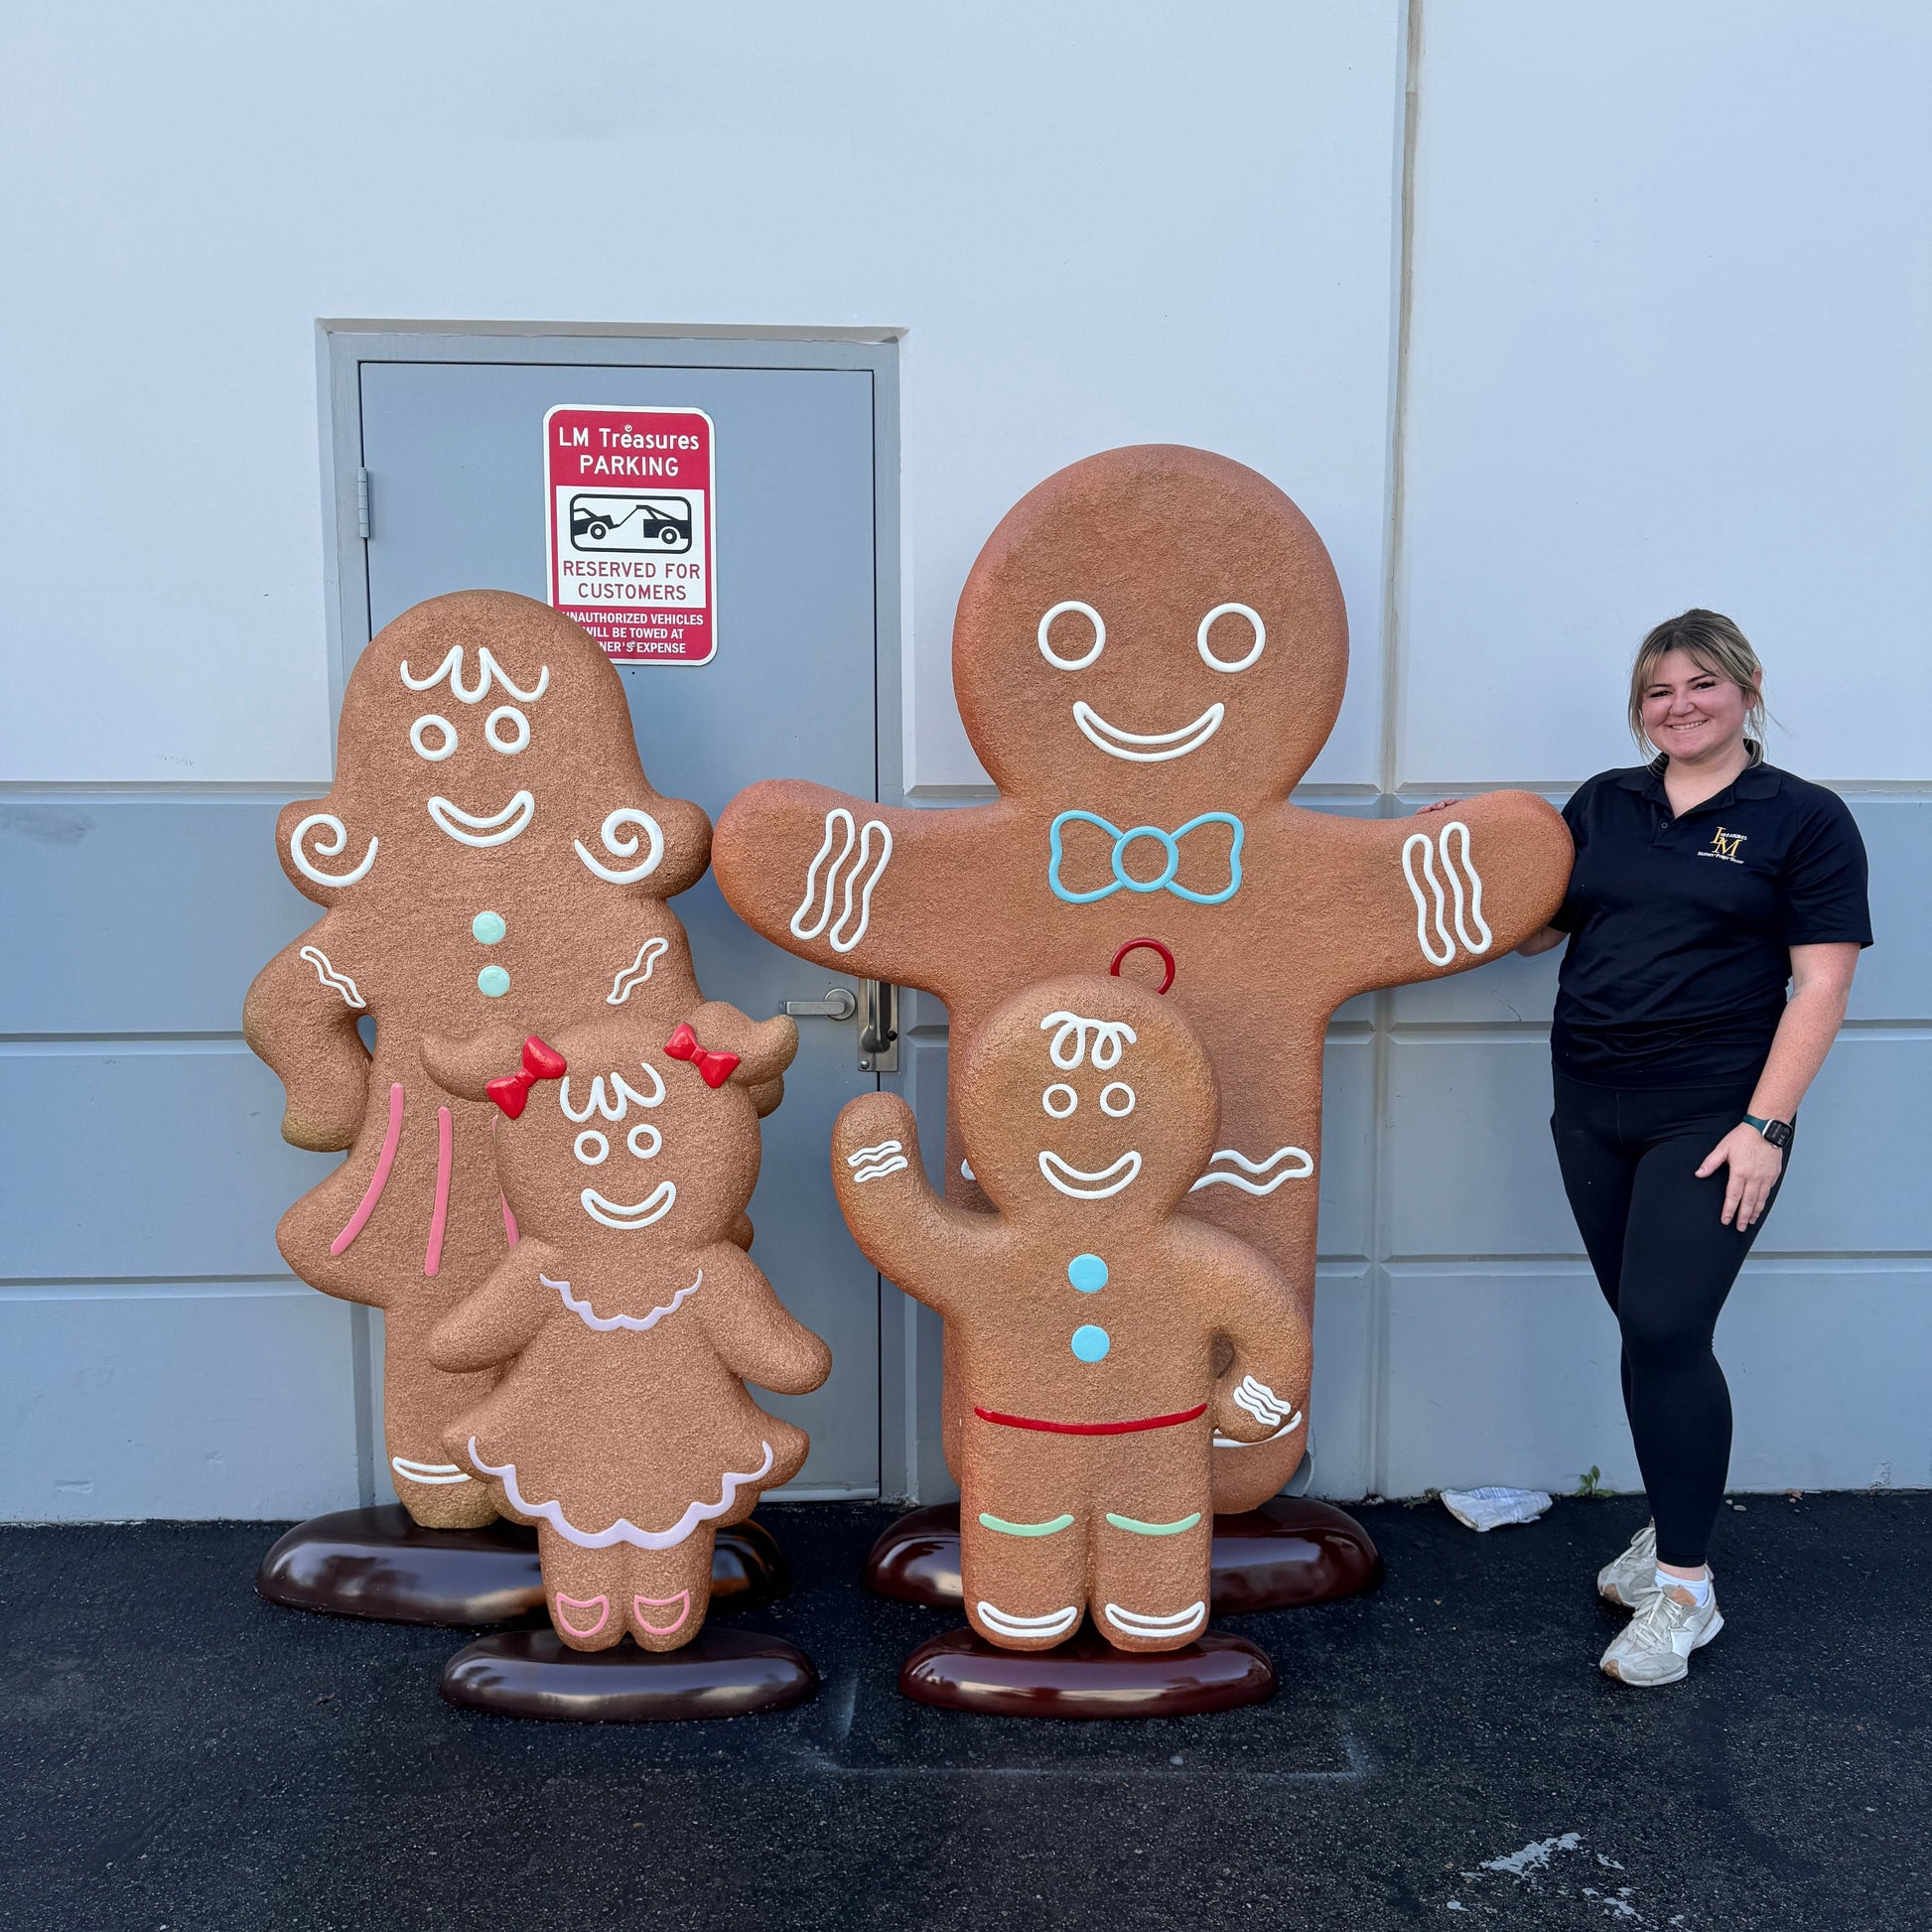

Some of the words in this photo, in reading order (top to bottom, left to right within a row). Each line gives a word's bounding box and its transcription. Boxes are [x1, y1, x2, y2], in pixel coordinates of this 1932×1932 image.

[559, 426, 589, 447] LM
[599, 428, 700, 450] Treasures
[580, 455, 679, 477] PARKING
[563, 560, 656, 578] RESERVED
[665, 563, 701, 580] FOR
[578, 583, 687, 601] CUSTOMERS
[650, 614, 704, 625] VEHICLES
[613, 627, 627, 638] BE
[629, 627, 668, 639] TOWED
[670, 628, 685, 639] AT
[597, 640, 634, 652] NER'S
[636, 642, 686, 653] EXPENSE
